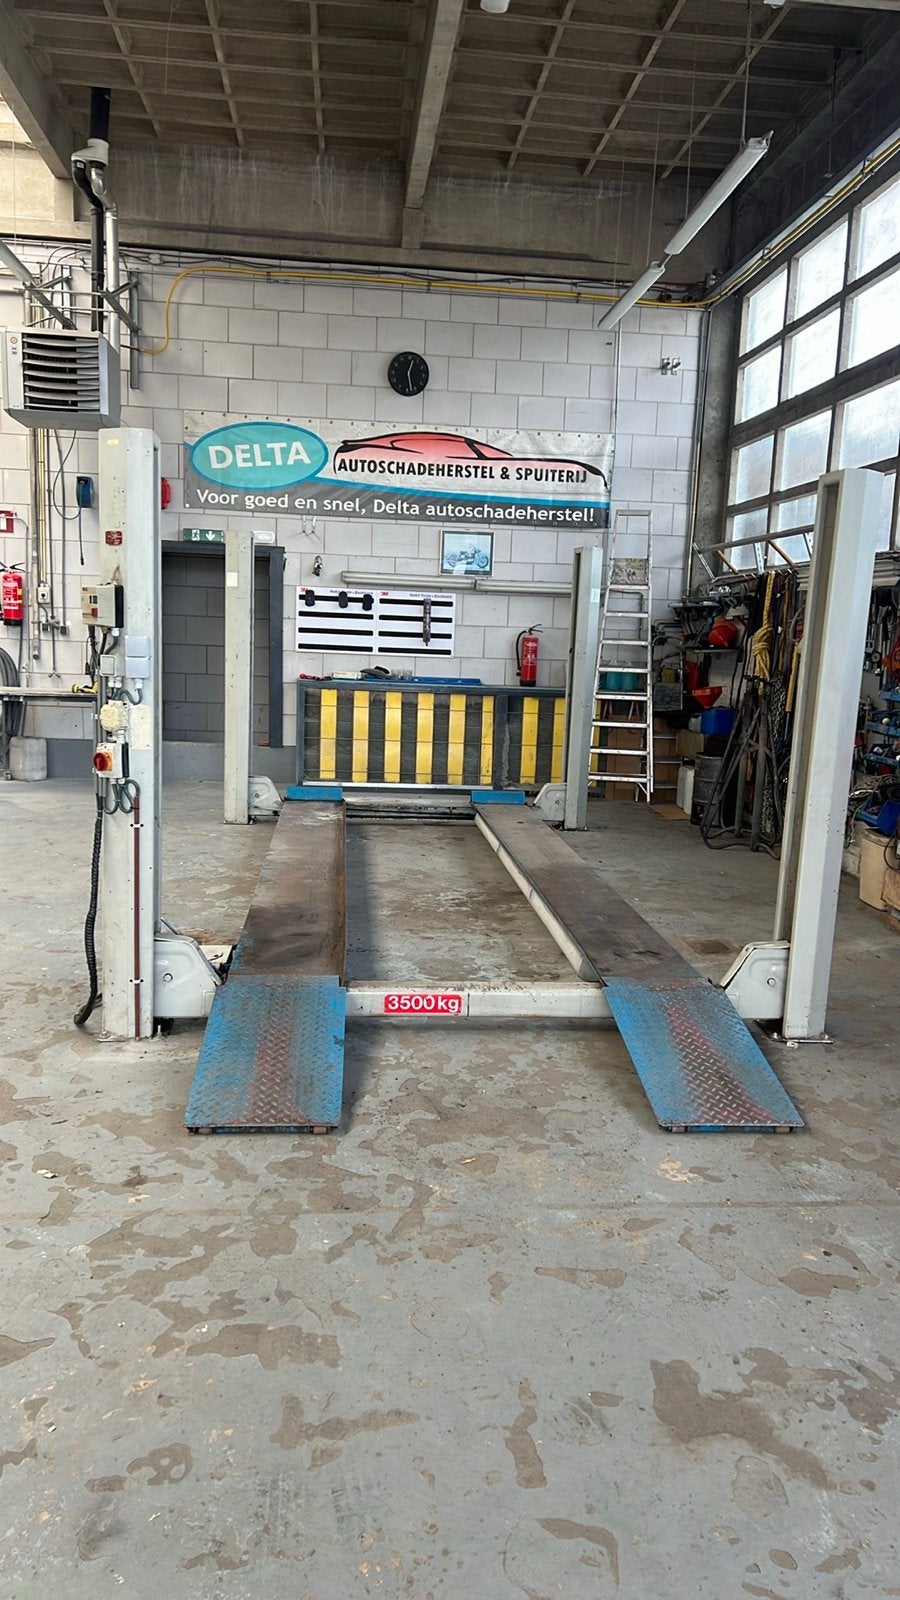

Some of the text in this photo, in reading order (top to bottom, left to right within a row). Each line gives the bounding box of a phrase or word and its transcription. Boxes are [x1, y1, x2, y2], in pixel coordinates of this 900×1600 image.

[207, 441, 312, 469] DELTA
[337, 458, 588, 483] AUTOSCHADEHERSTEL & SPUITERIJ
[196, 488, 595, 522] Voor goed en snel, Delta autoschadeherstel!
[387, 995, 460, 1013] 3500 kg
